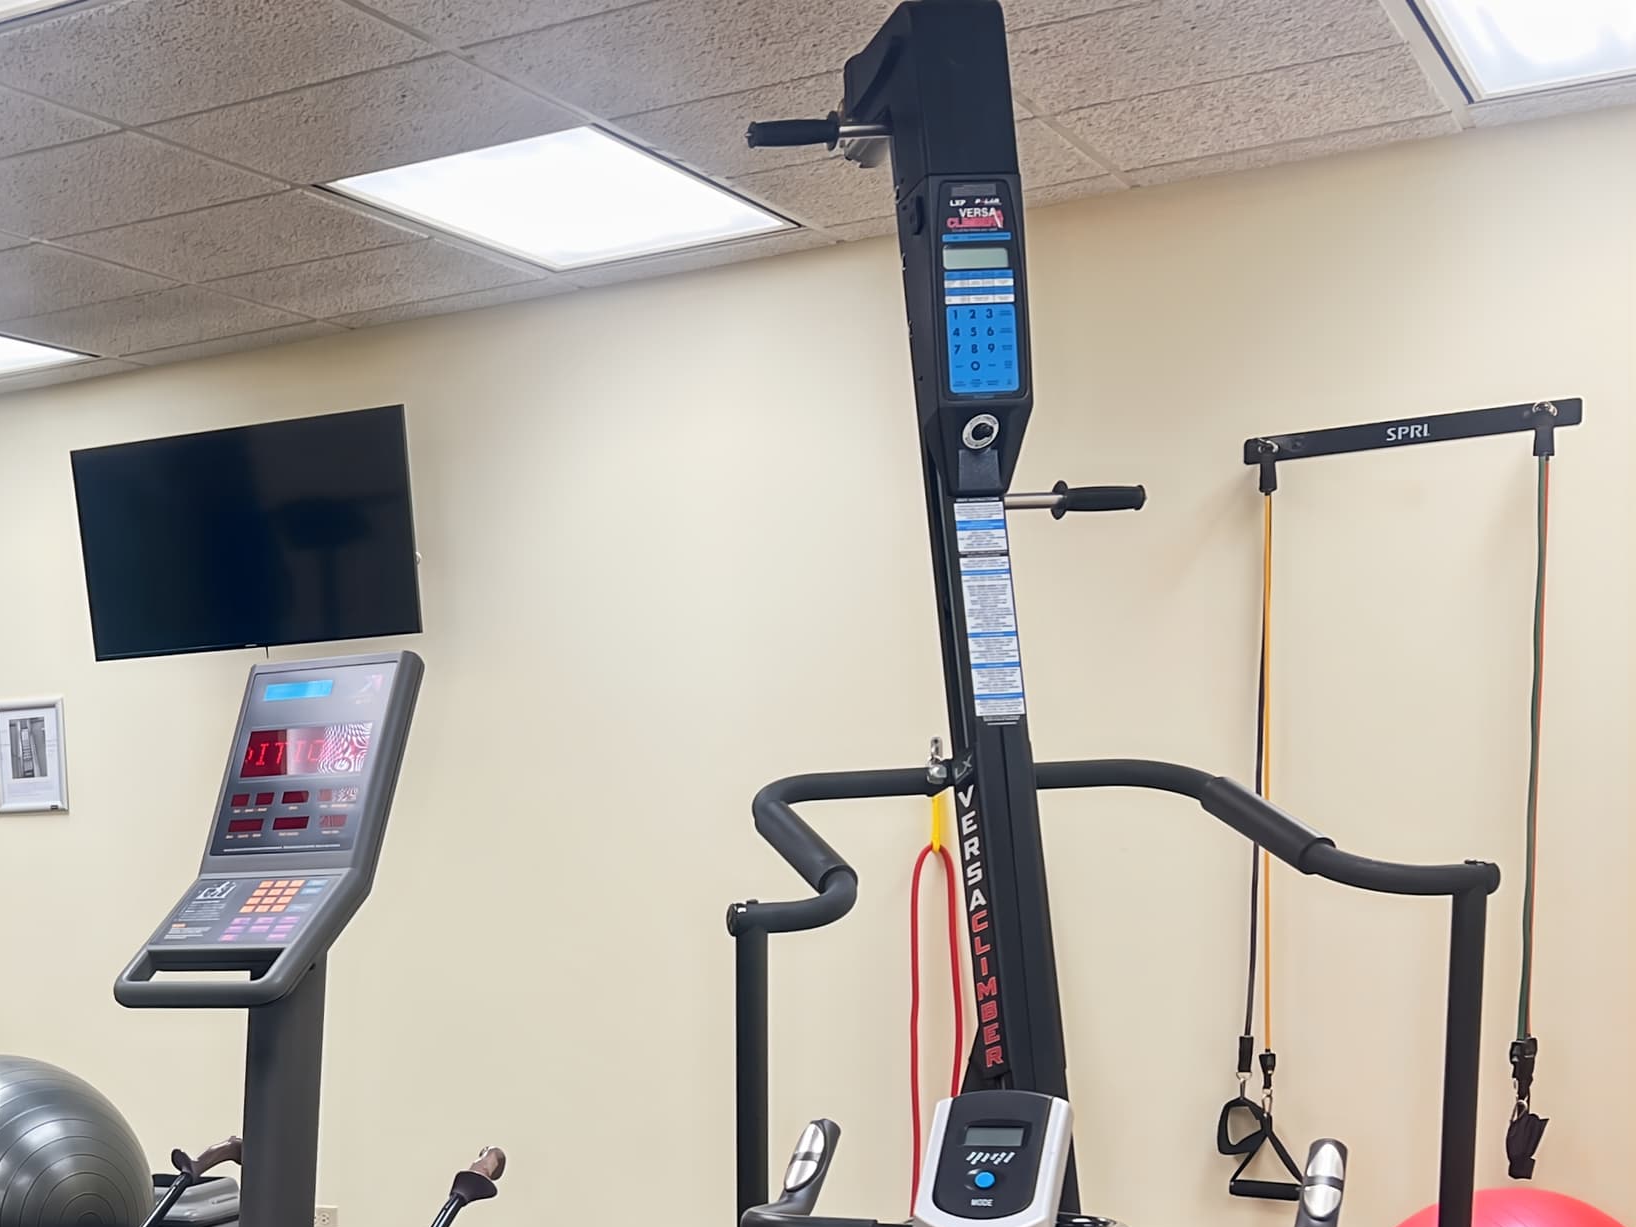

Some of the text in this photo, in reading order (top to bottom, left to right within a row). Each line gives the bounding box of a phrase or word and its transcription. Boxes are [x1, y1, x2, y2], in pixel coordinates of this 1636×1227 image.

[959, 207, 997, 218] VERSA
[953, 308, 993, 320] 1 2 3
[952, 326, 994, 337] 4 5 6
[954, 343, 995, 355] 7 8 9
[1386, 423, 1429, 441] SPRI
